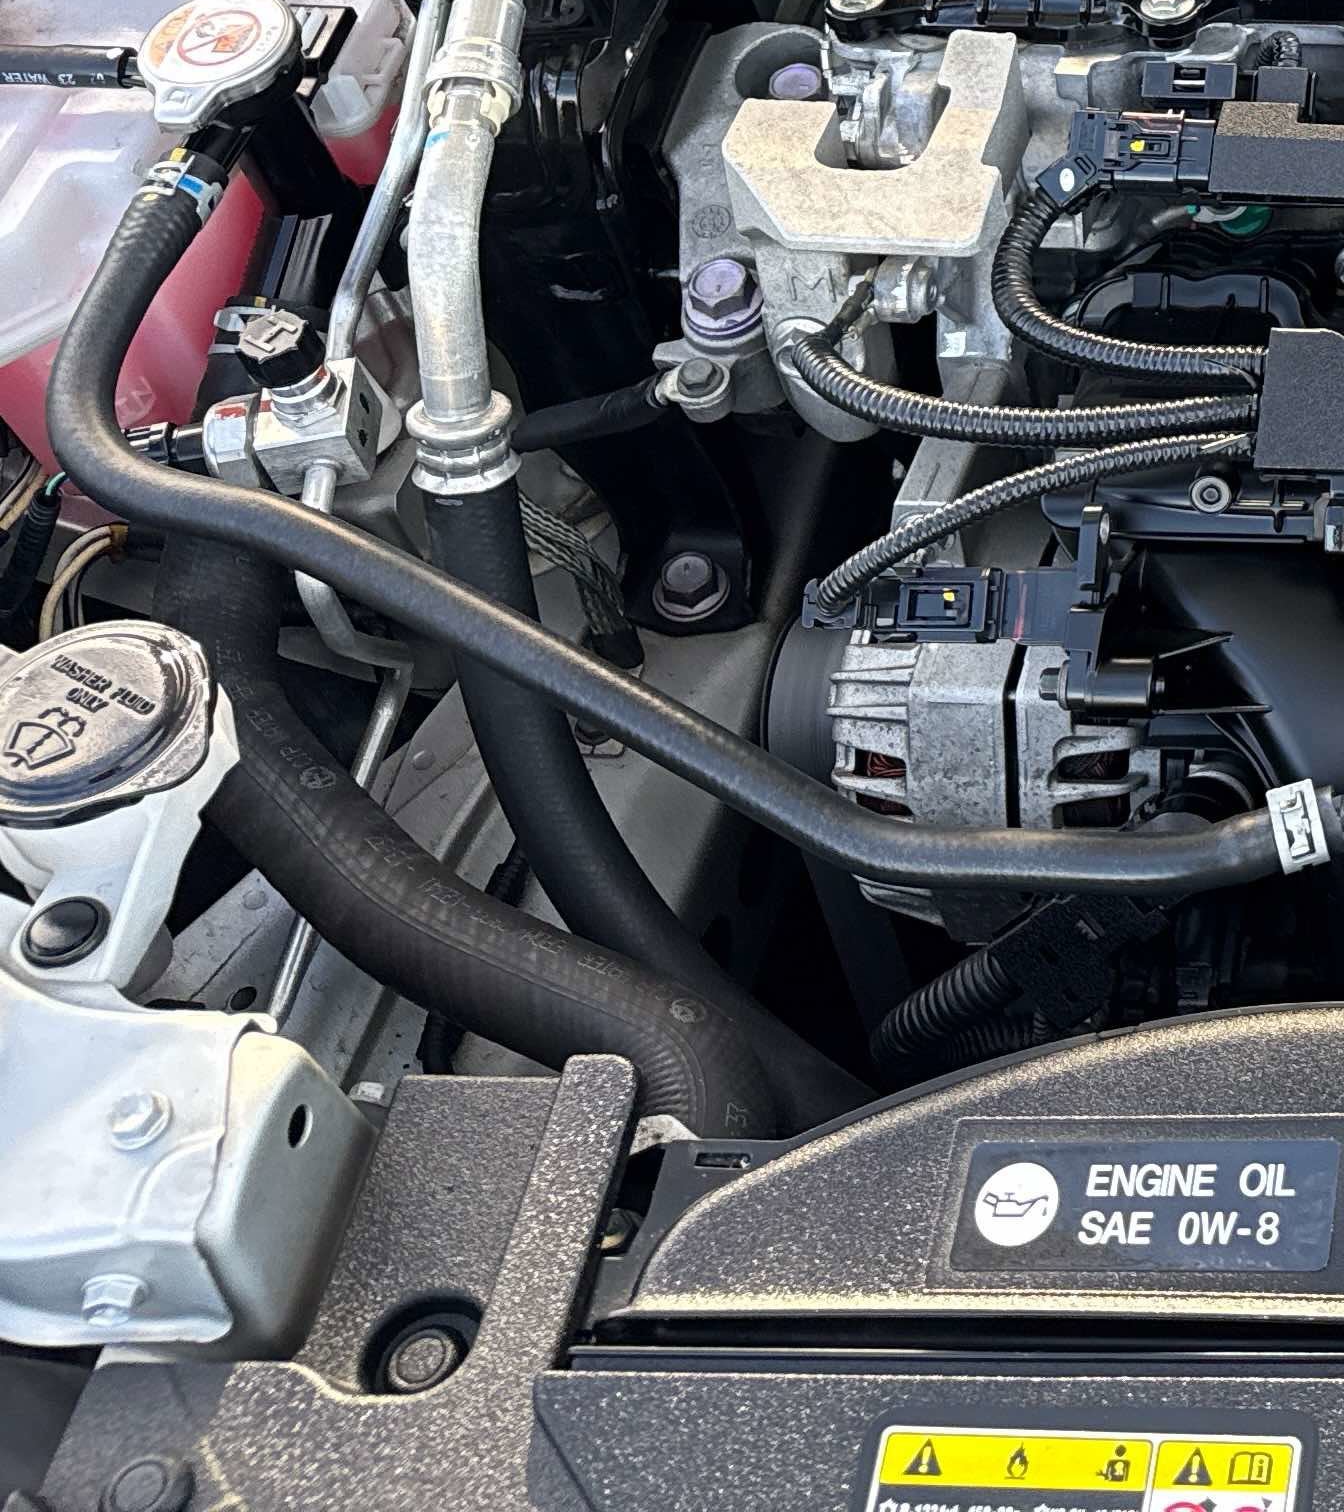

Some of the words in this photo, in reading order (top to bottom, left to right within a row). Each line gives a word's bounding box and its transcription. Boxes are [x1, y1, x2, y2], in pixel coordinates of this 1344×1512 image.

[1, 71, 51, 84] WATER
[50, 654, 113, 693] WASHER
[109, 686, 156, 715] FLUID
[66, 687, 109, 714] ONLY
[1085, 1163, 1216, 1199] ENGINE
[1238, 1163, 1296, 1199] OIL
[1077, 1211, 1153, 1247] SAE
[1177, 1211, 1281, 1247] 0W-8
